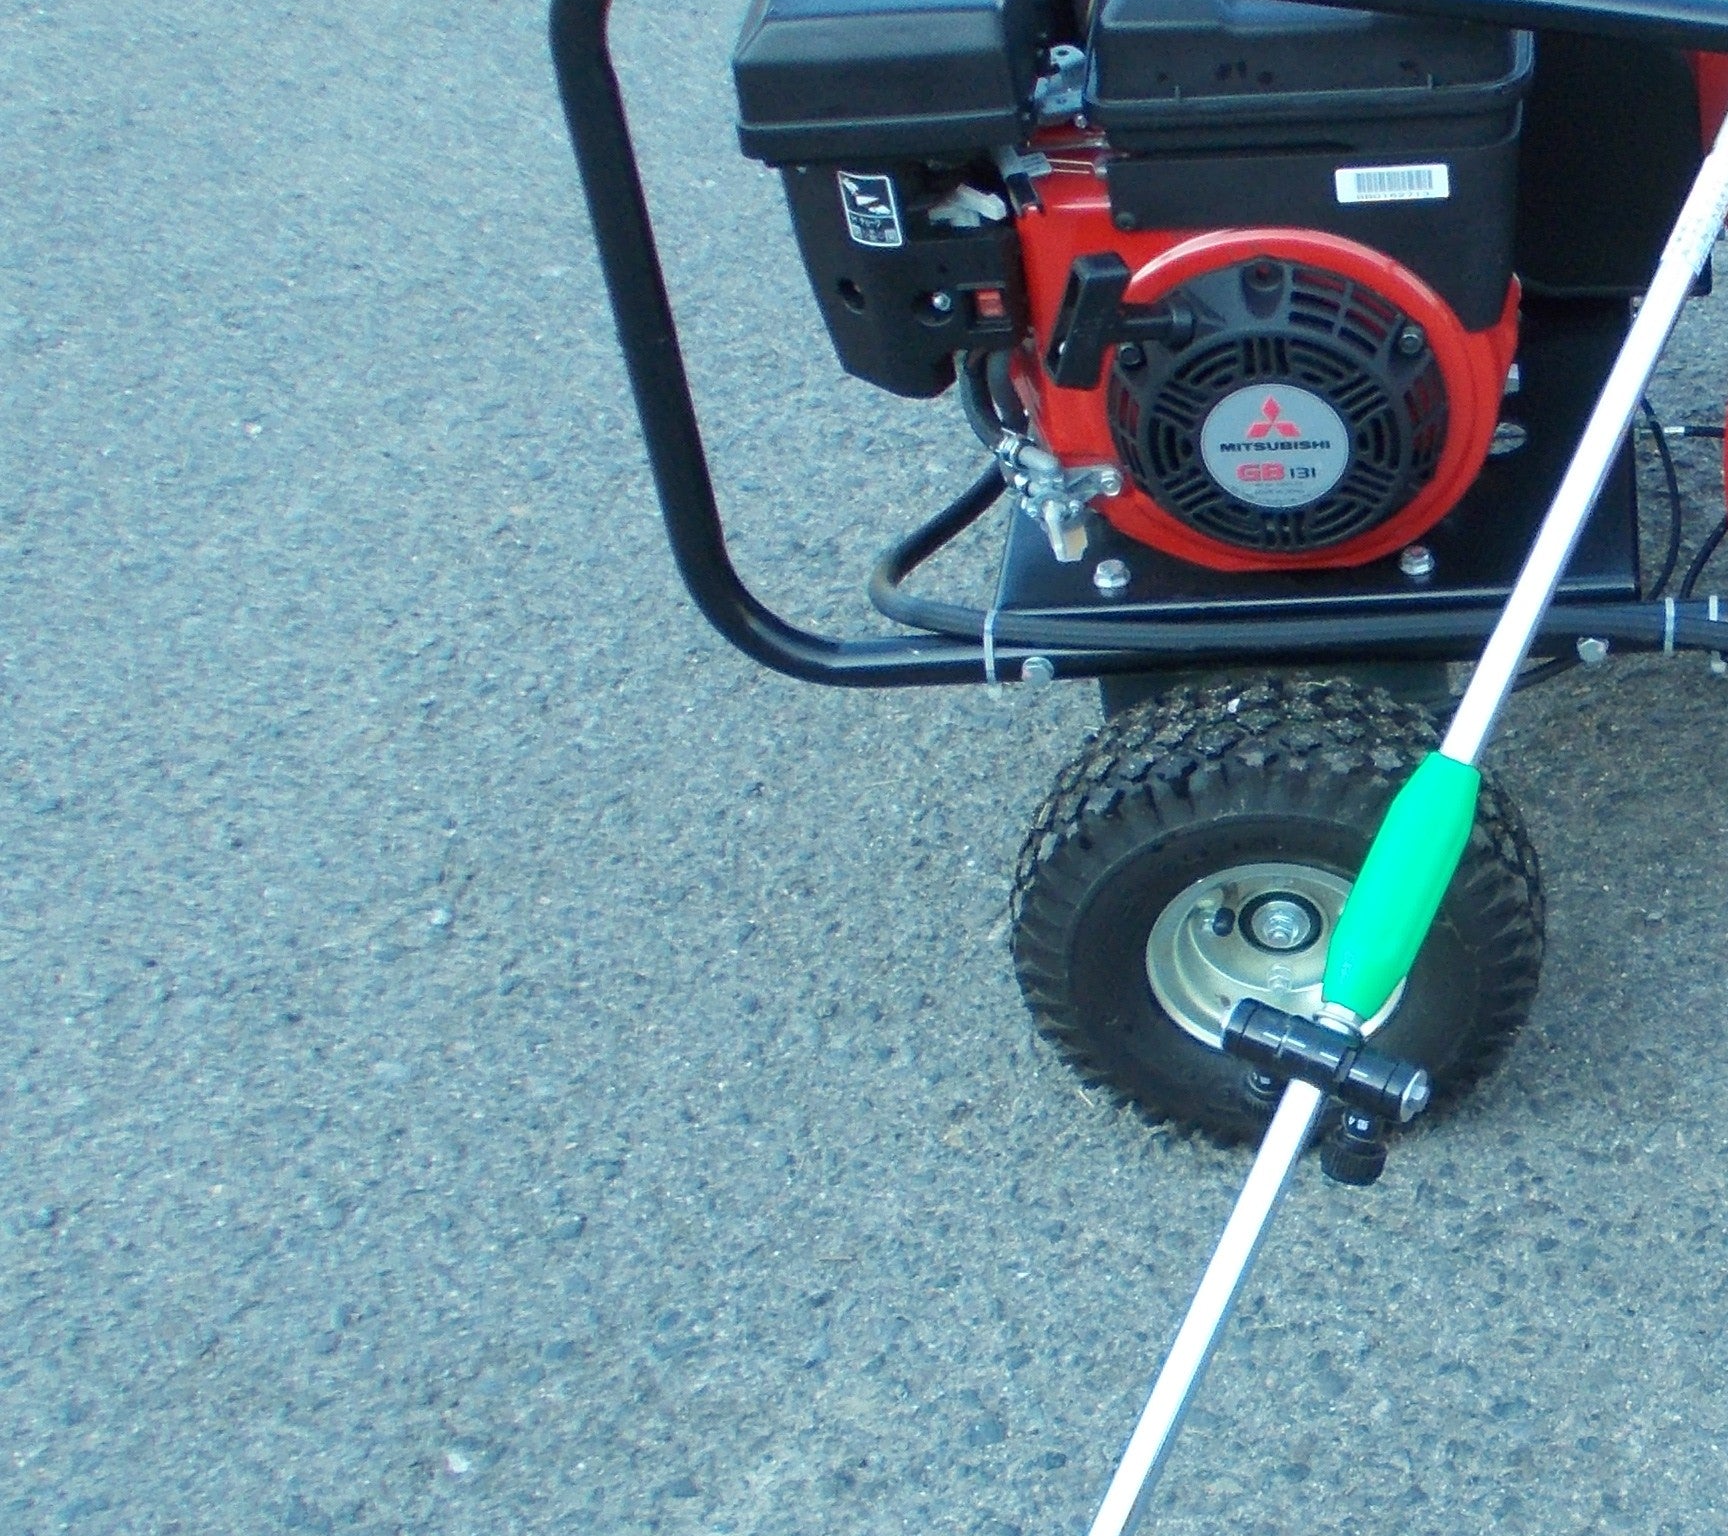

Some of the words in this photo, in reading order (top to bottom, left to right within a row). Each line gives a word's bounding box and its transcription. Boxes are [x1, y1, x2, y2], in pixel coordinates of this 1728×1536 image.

[1220, 440, 1331, 452] MITSUBISHI
[1237, 462, 1284, 481] GB
[1290, 467, 1316, 479] 131
